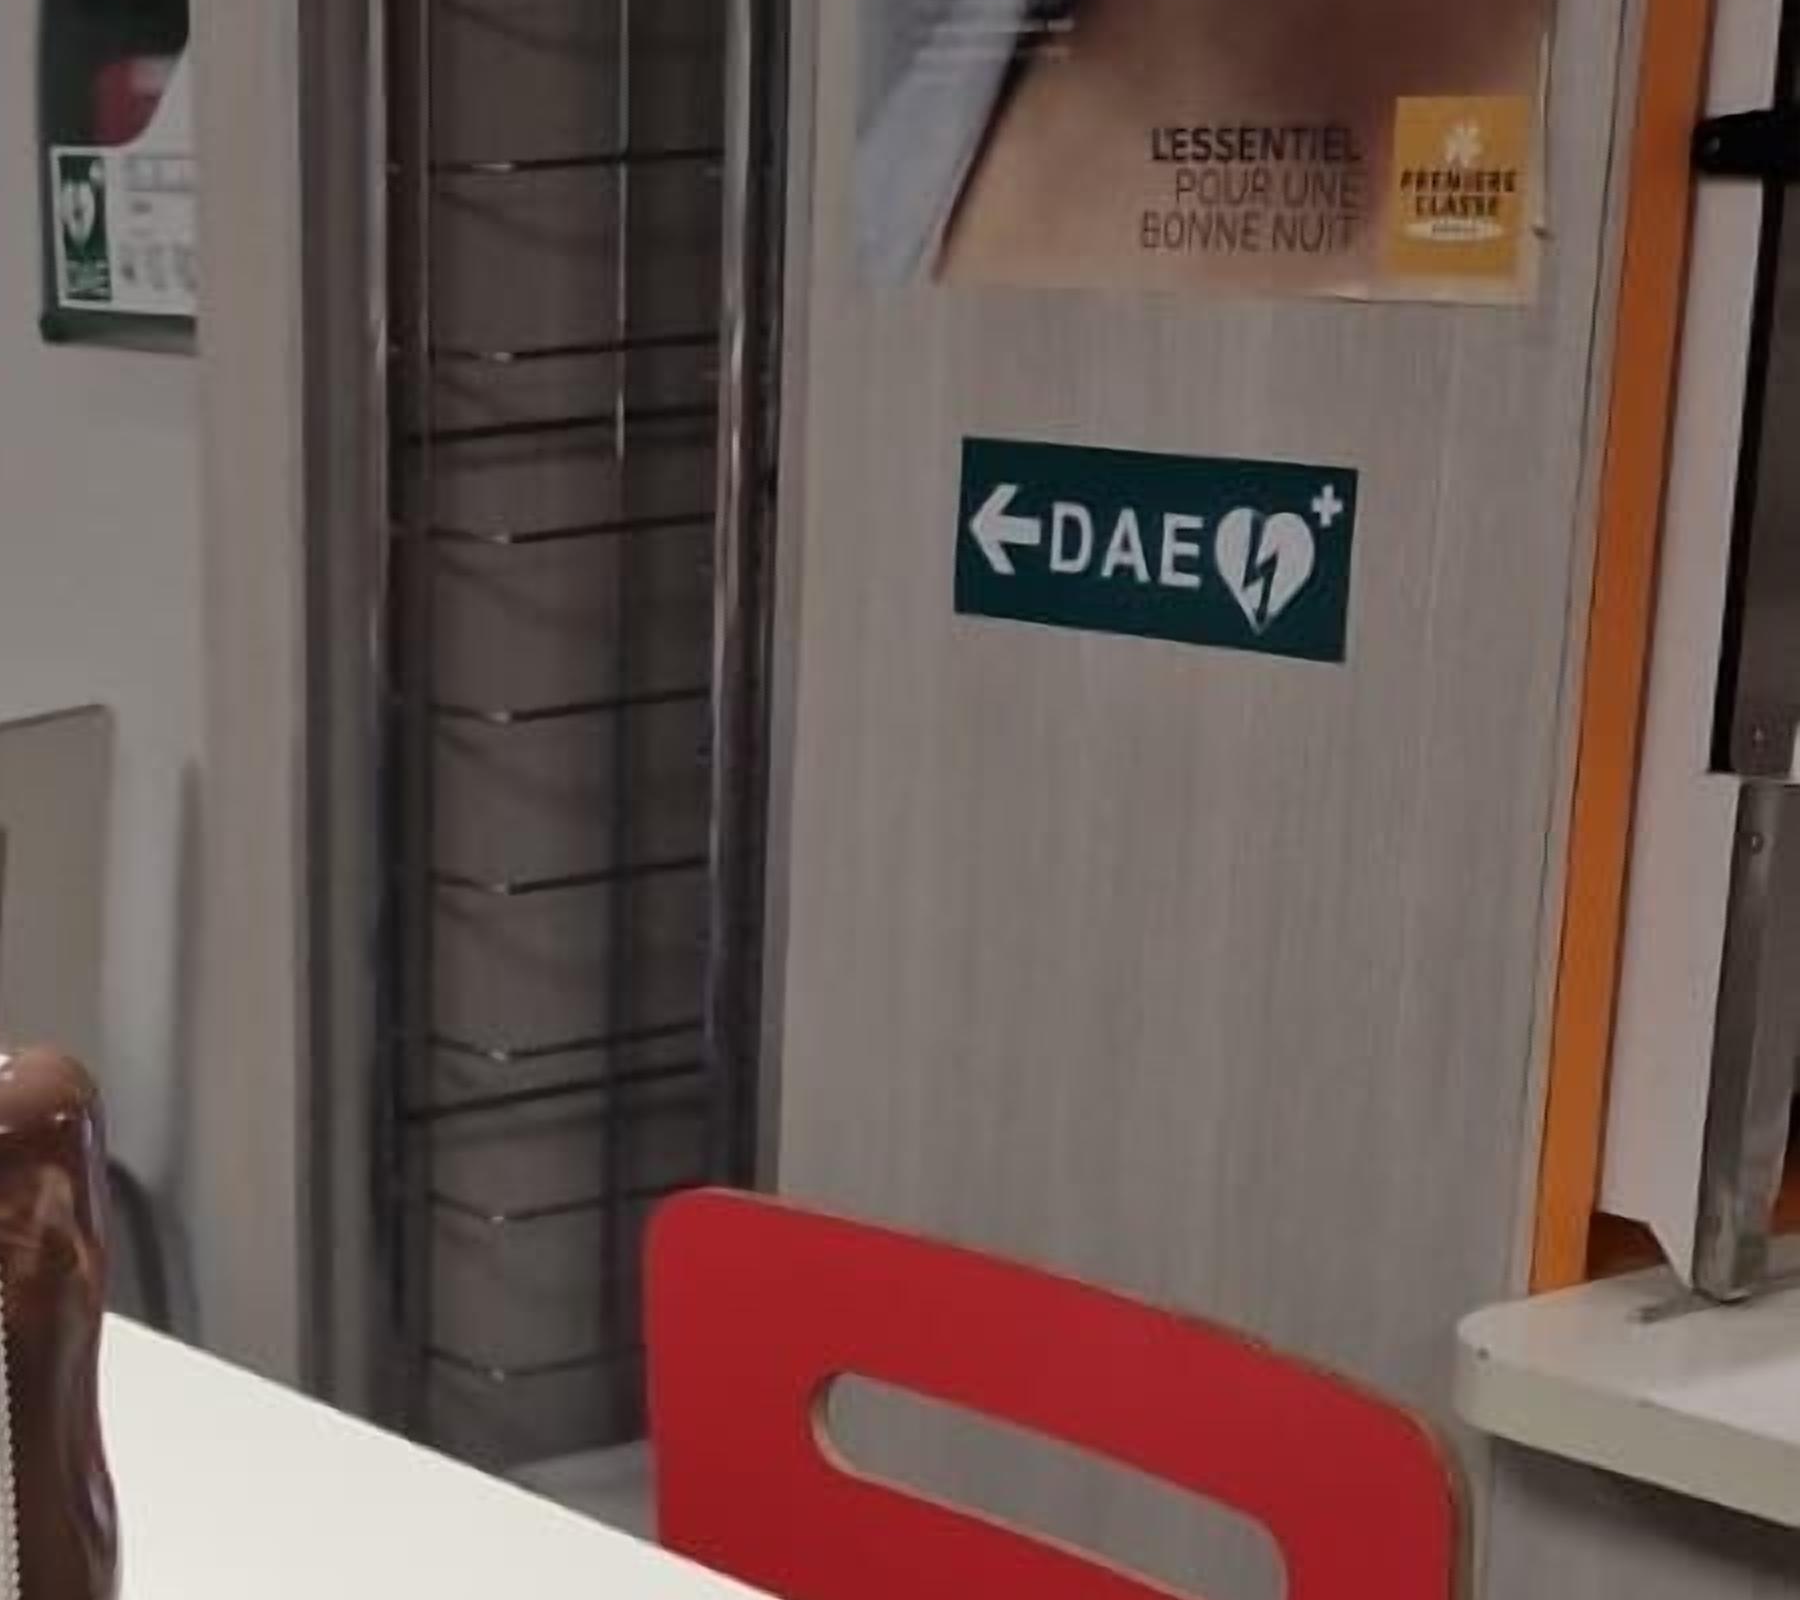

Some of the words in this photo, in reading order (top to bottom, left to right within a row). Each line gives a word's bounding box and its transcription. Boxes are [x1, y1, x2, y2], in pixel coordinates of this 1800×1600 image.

[1174, 166, 1276, 206] POUR
[1283, 169, 1364, 208] UNE
[1141, 209, 1266, 253] BONNE
[1272, 212, 1363, 253] NUIT
[1048, 500, 1203, 588] DAE
